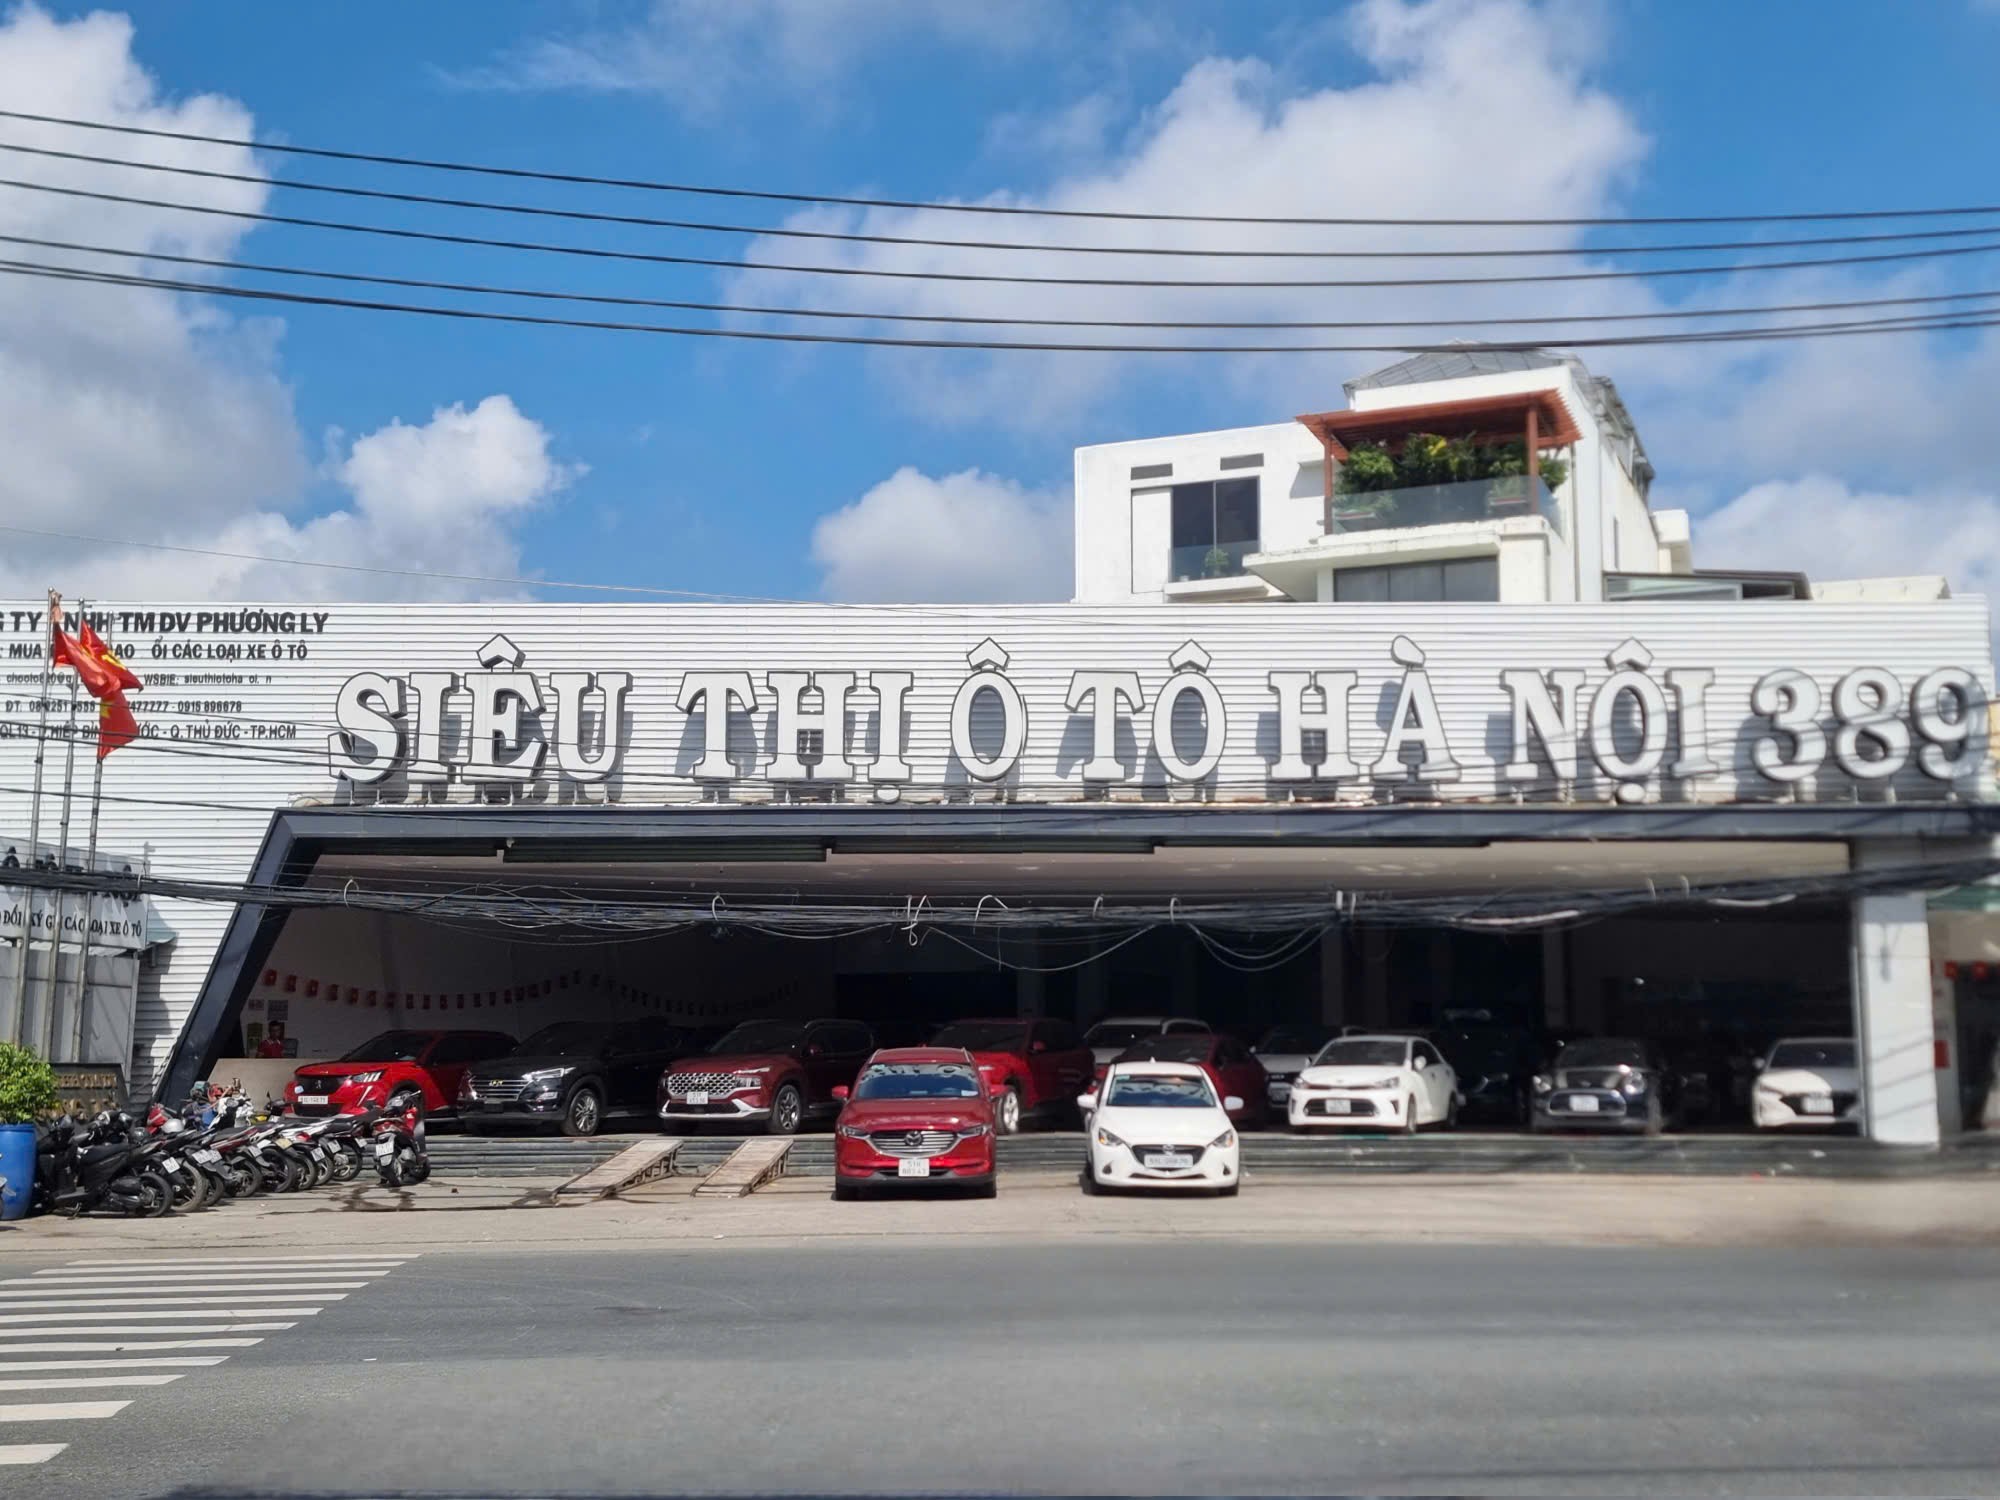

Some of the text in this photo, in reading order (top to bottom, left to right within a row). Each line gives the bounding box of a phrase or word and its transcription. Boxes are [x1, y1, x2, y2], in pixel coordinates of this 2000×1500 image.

[10, 611, 43, 632] TY
[62, 611, 112, 632] NHH
[160, 612, 192, 632] DV
[196, 607, 297, 634] PHƯƠNG
[300, 612, 329, 634] LY
[9, 643, 43, 659] MUA
[172, 639, 203, 660] CÁC
[207, 643, 242, 663] LOẠI
[247, 644, 266, 660] XE
[271, 639, 282, 661] Ô
[287, 639, 308, 661] TÔ
[328, 633, 1990, 802] SIÊU THỊ Ô TÔ HÀ NỘI 389
[250, 724, 297, 740] TP.HCM
